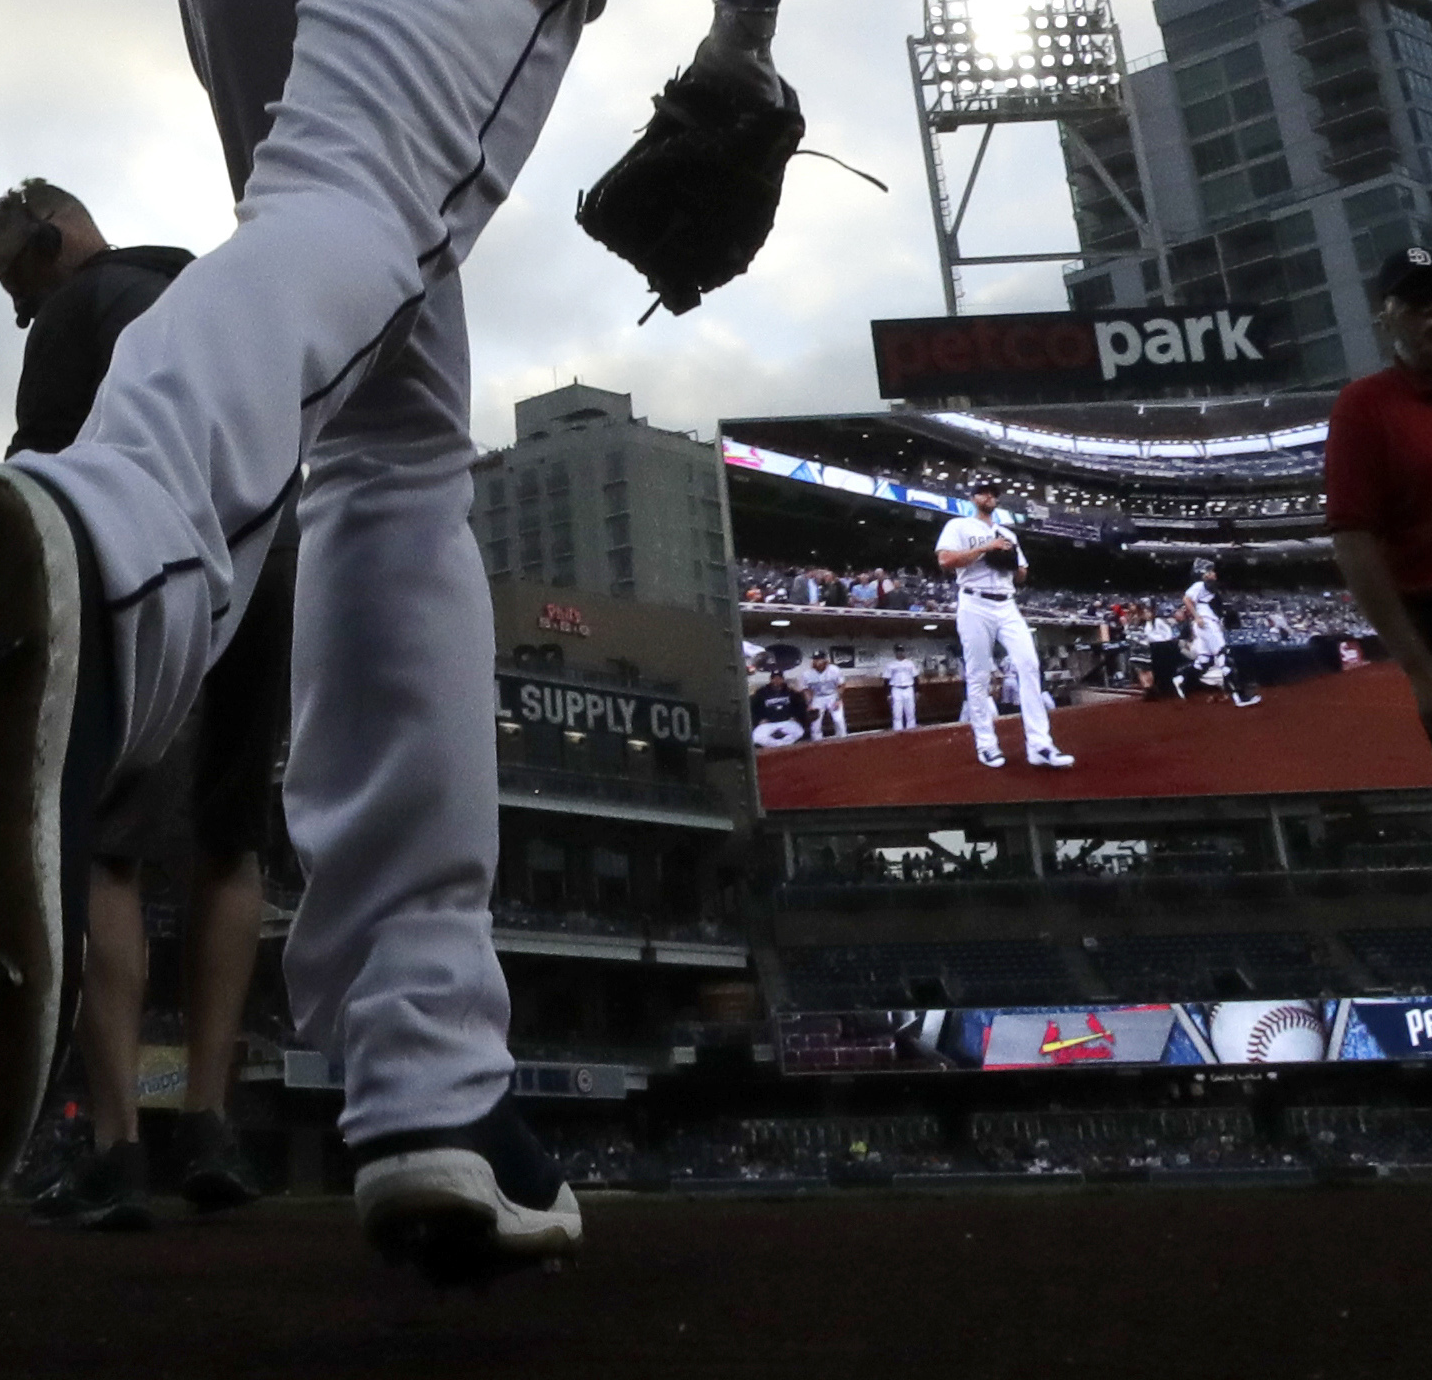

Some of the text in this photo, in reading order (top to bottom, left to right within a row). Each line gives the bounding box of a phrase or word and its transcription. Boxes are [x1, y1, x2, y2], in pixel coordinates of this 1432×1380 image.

[1094, 310, 1264, 381] park
[520, 683, 637, 736] SUPPLY
[650, 702, 700, 743] CO.
